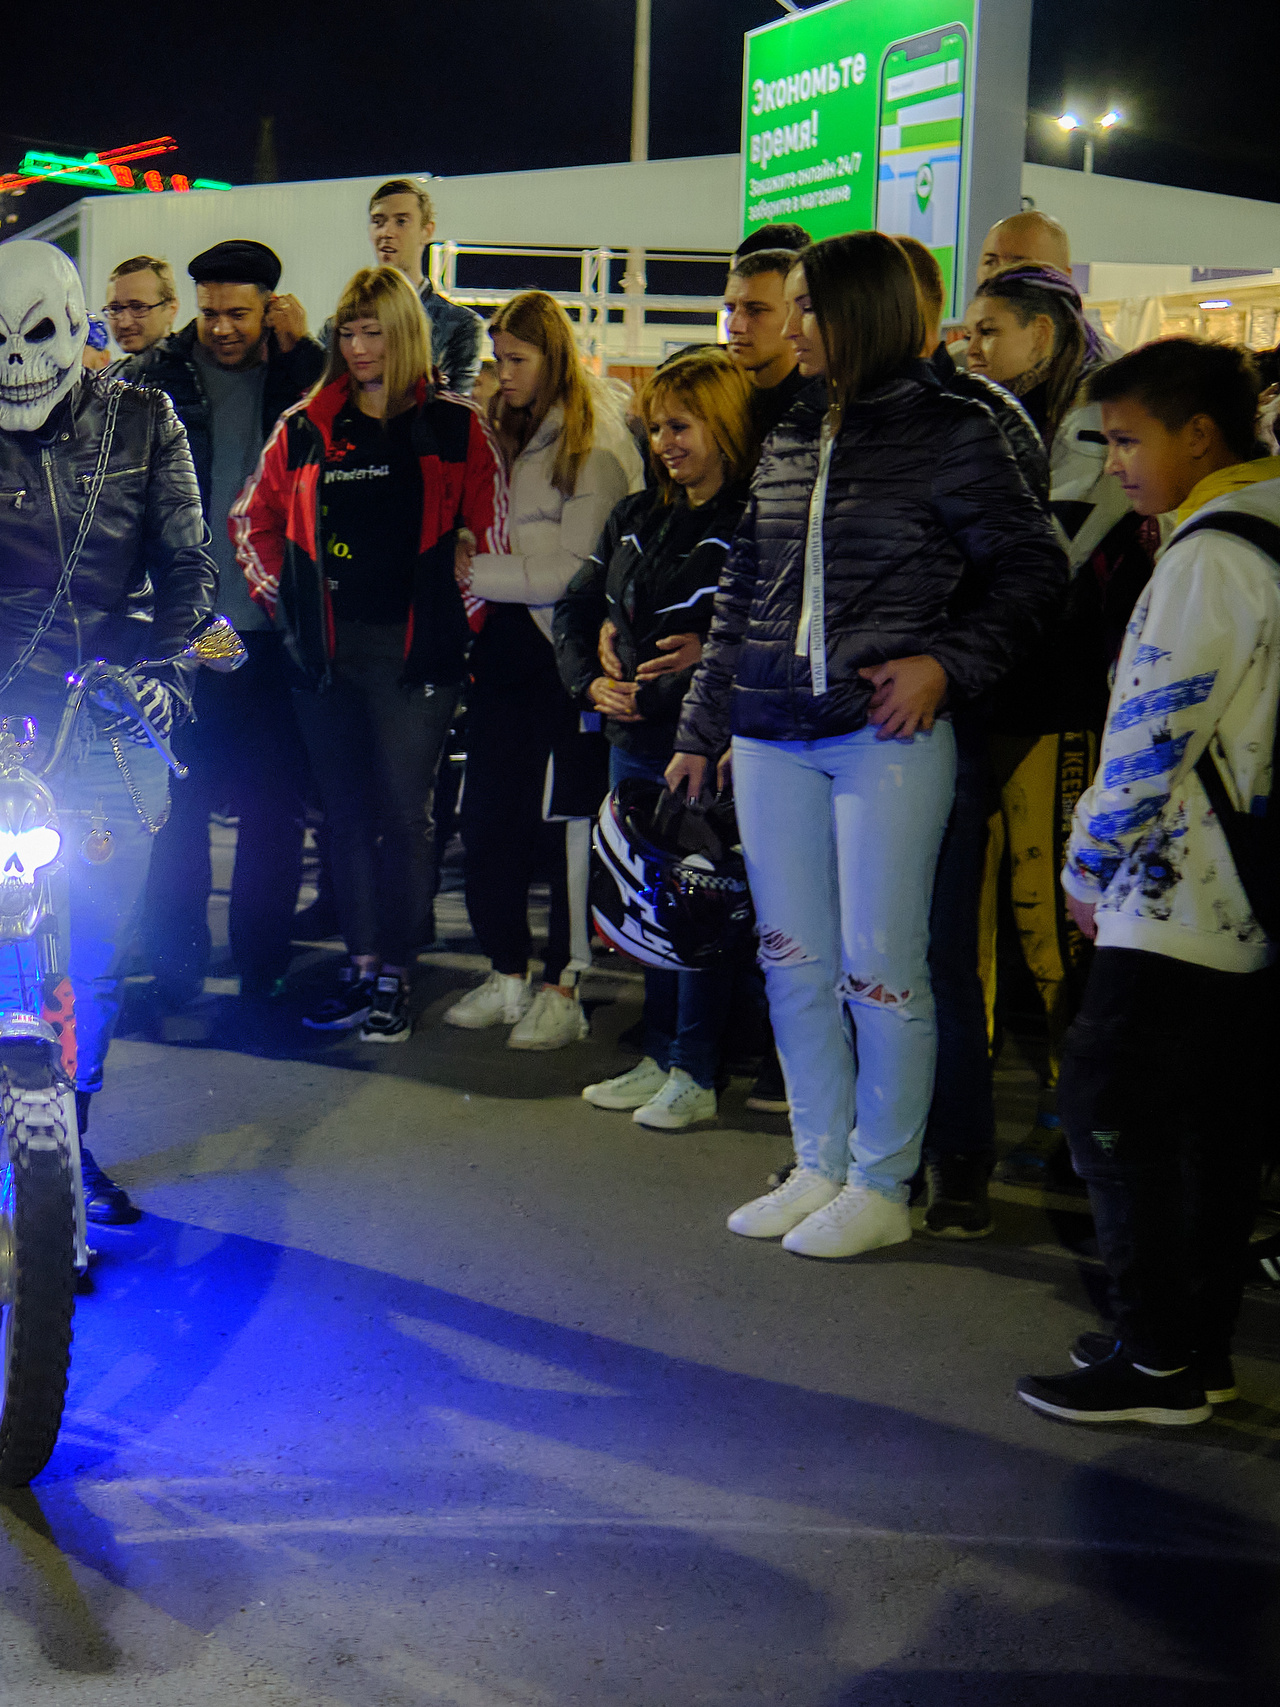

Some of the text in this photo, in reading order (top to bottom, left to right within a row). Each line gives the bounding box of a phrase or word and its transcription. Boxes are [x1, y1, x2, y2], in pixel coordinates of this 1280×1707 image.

[751, 52, 867, 116] Экономьте
[749, 109, 819, 170] время!
[797, 159, 836, 186] онлайн
[836, 151, 862, 176] 24/7
[799, 184, 851, 210] магазине
[812, 513, 821, 576] NORTH STAR
[812, 586, 821, 650] NORTH STAR
[813, 662, 824, 688] STAR
